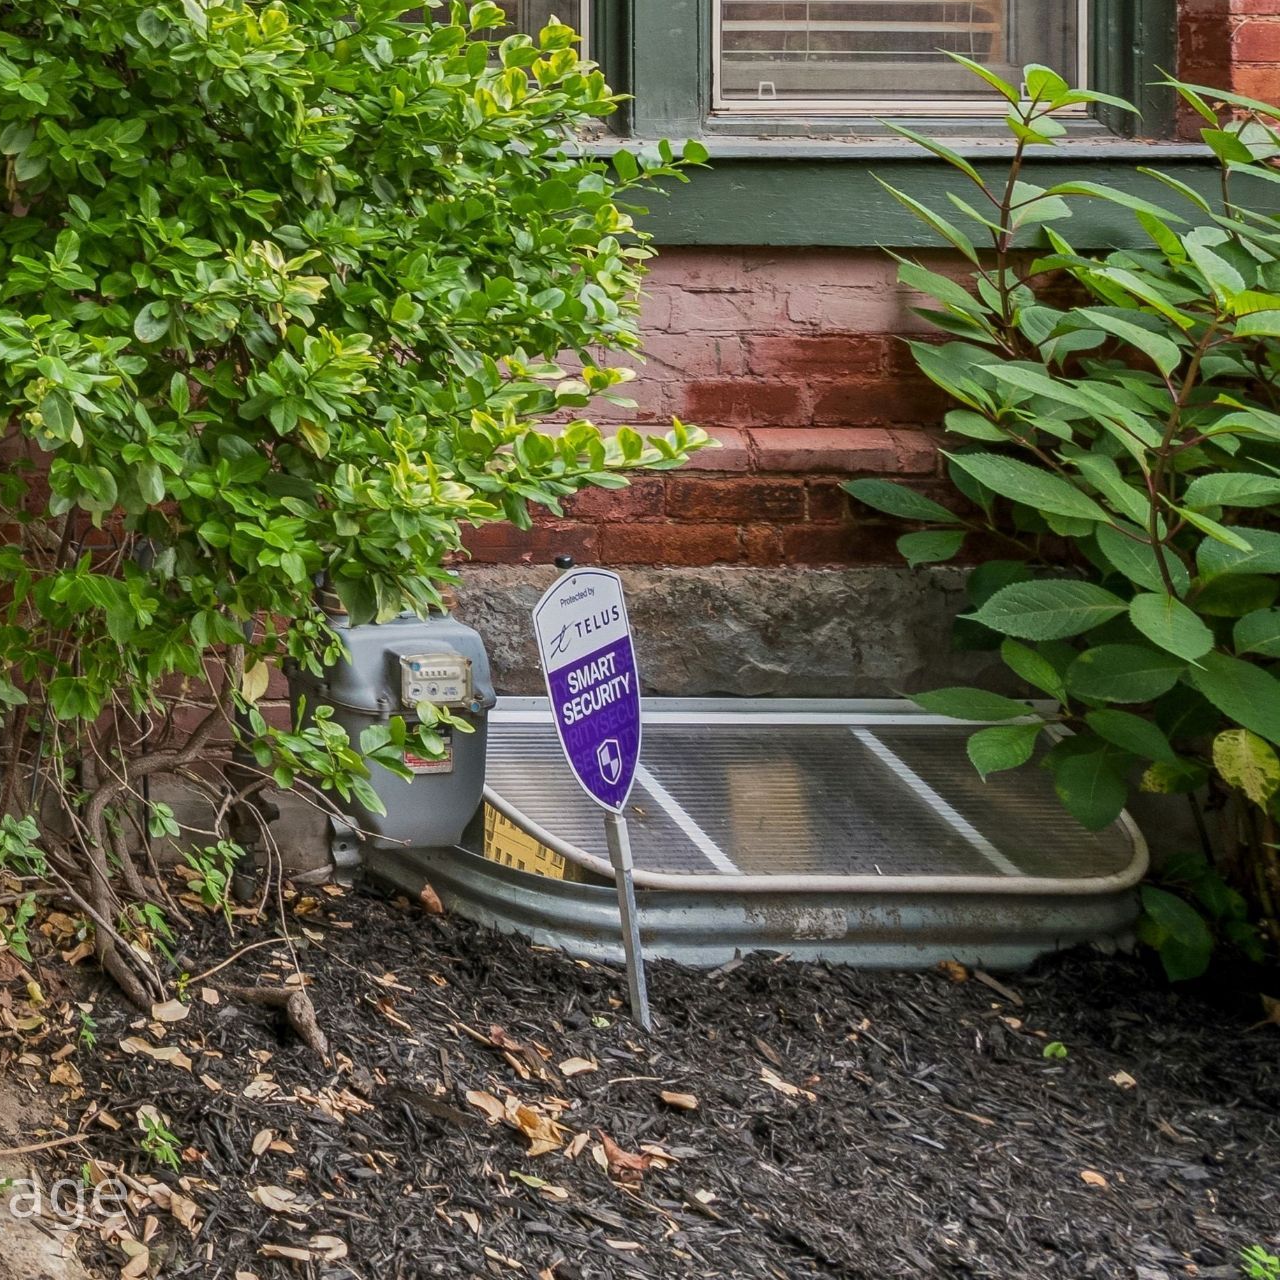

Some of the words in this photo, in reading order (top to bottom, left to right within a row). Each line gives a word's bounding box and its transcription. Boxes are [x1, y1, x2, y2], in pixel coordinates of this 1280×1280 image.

[560, 588, 587, 608] Protected
[587, 587, 595, 597] by
[574, 605, 620, 638] TELUS
[567, 652, 616, 694] SMART
[562, 672, 630, 725] SECURITY
